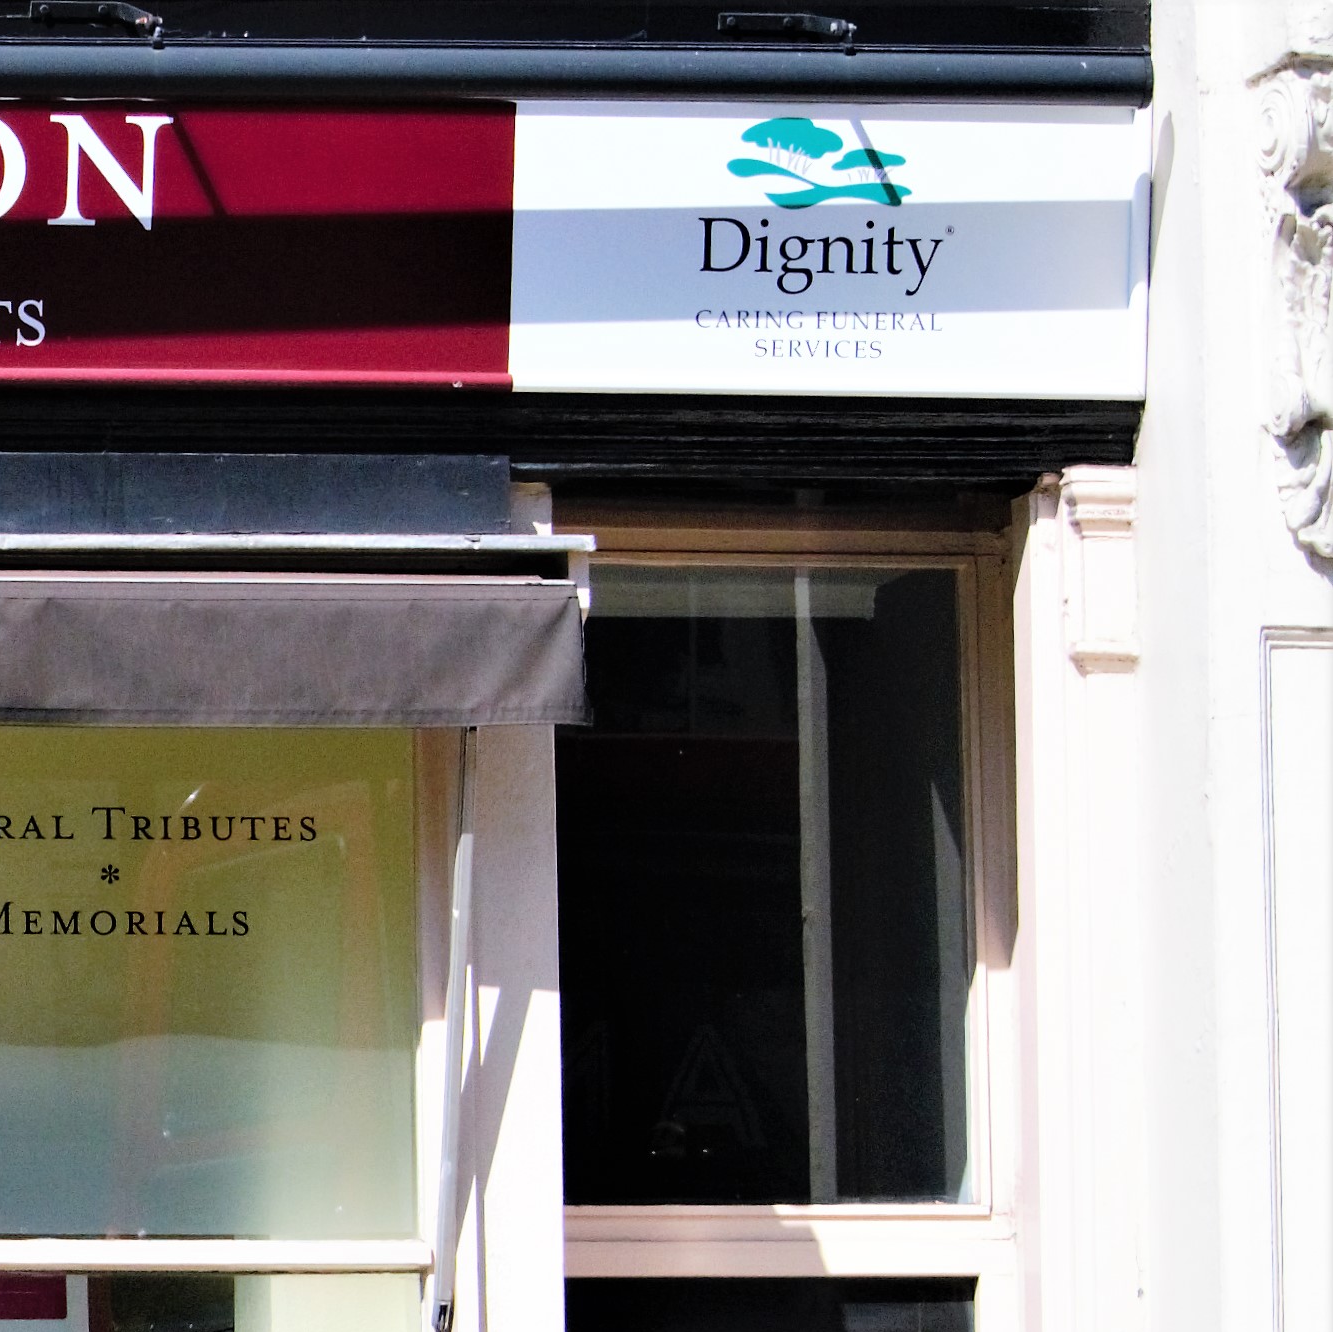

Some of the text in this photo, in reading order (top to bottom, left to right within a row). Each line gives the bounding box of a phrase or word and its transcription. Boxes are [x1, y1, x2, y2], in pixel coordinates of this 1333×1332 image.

[694, 308, 944, 332] CARING FUNERAL
[754, 339, 883, 359] SERVICES
[91, 806, 319, 843] TRIBUTES
